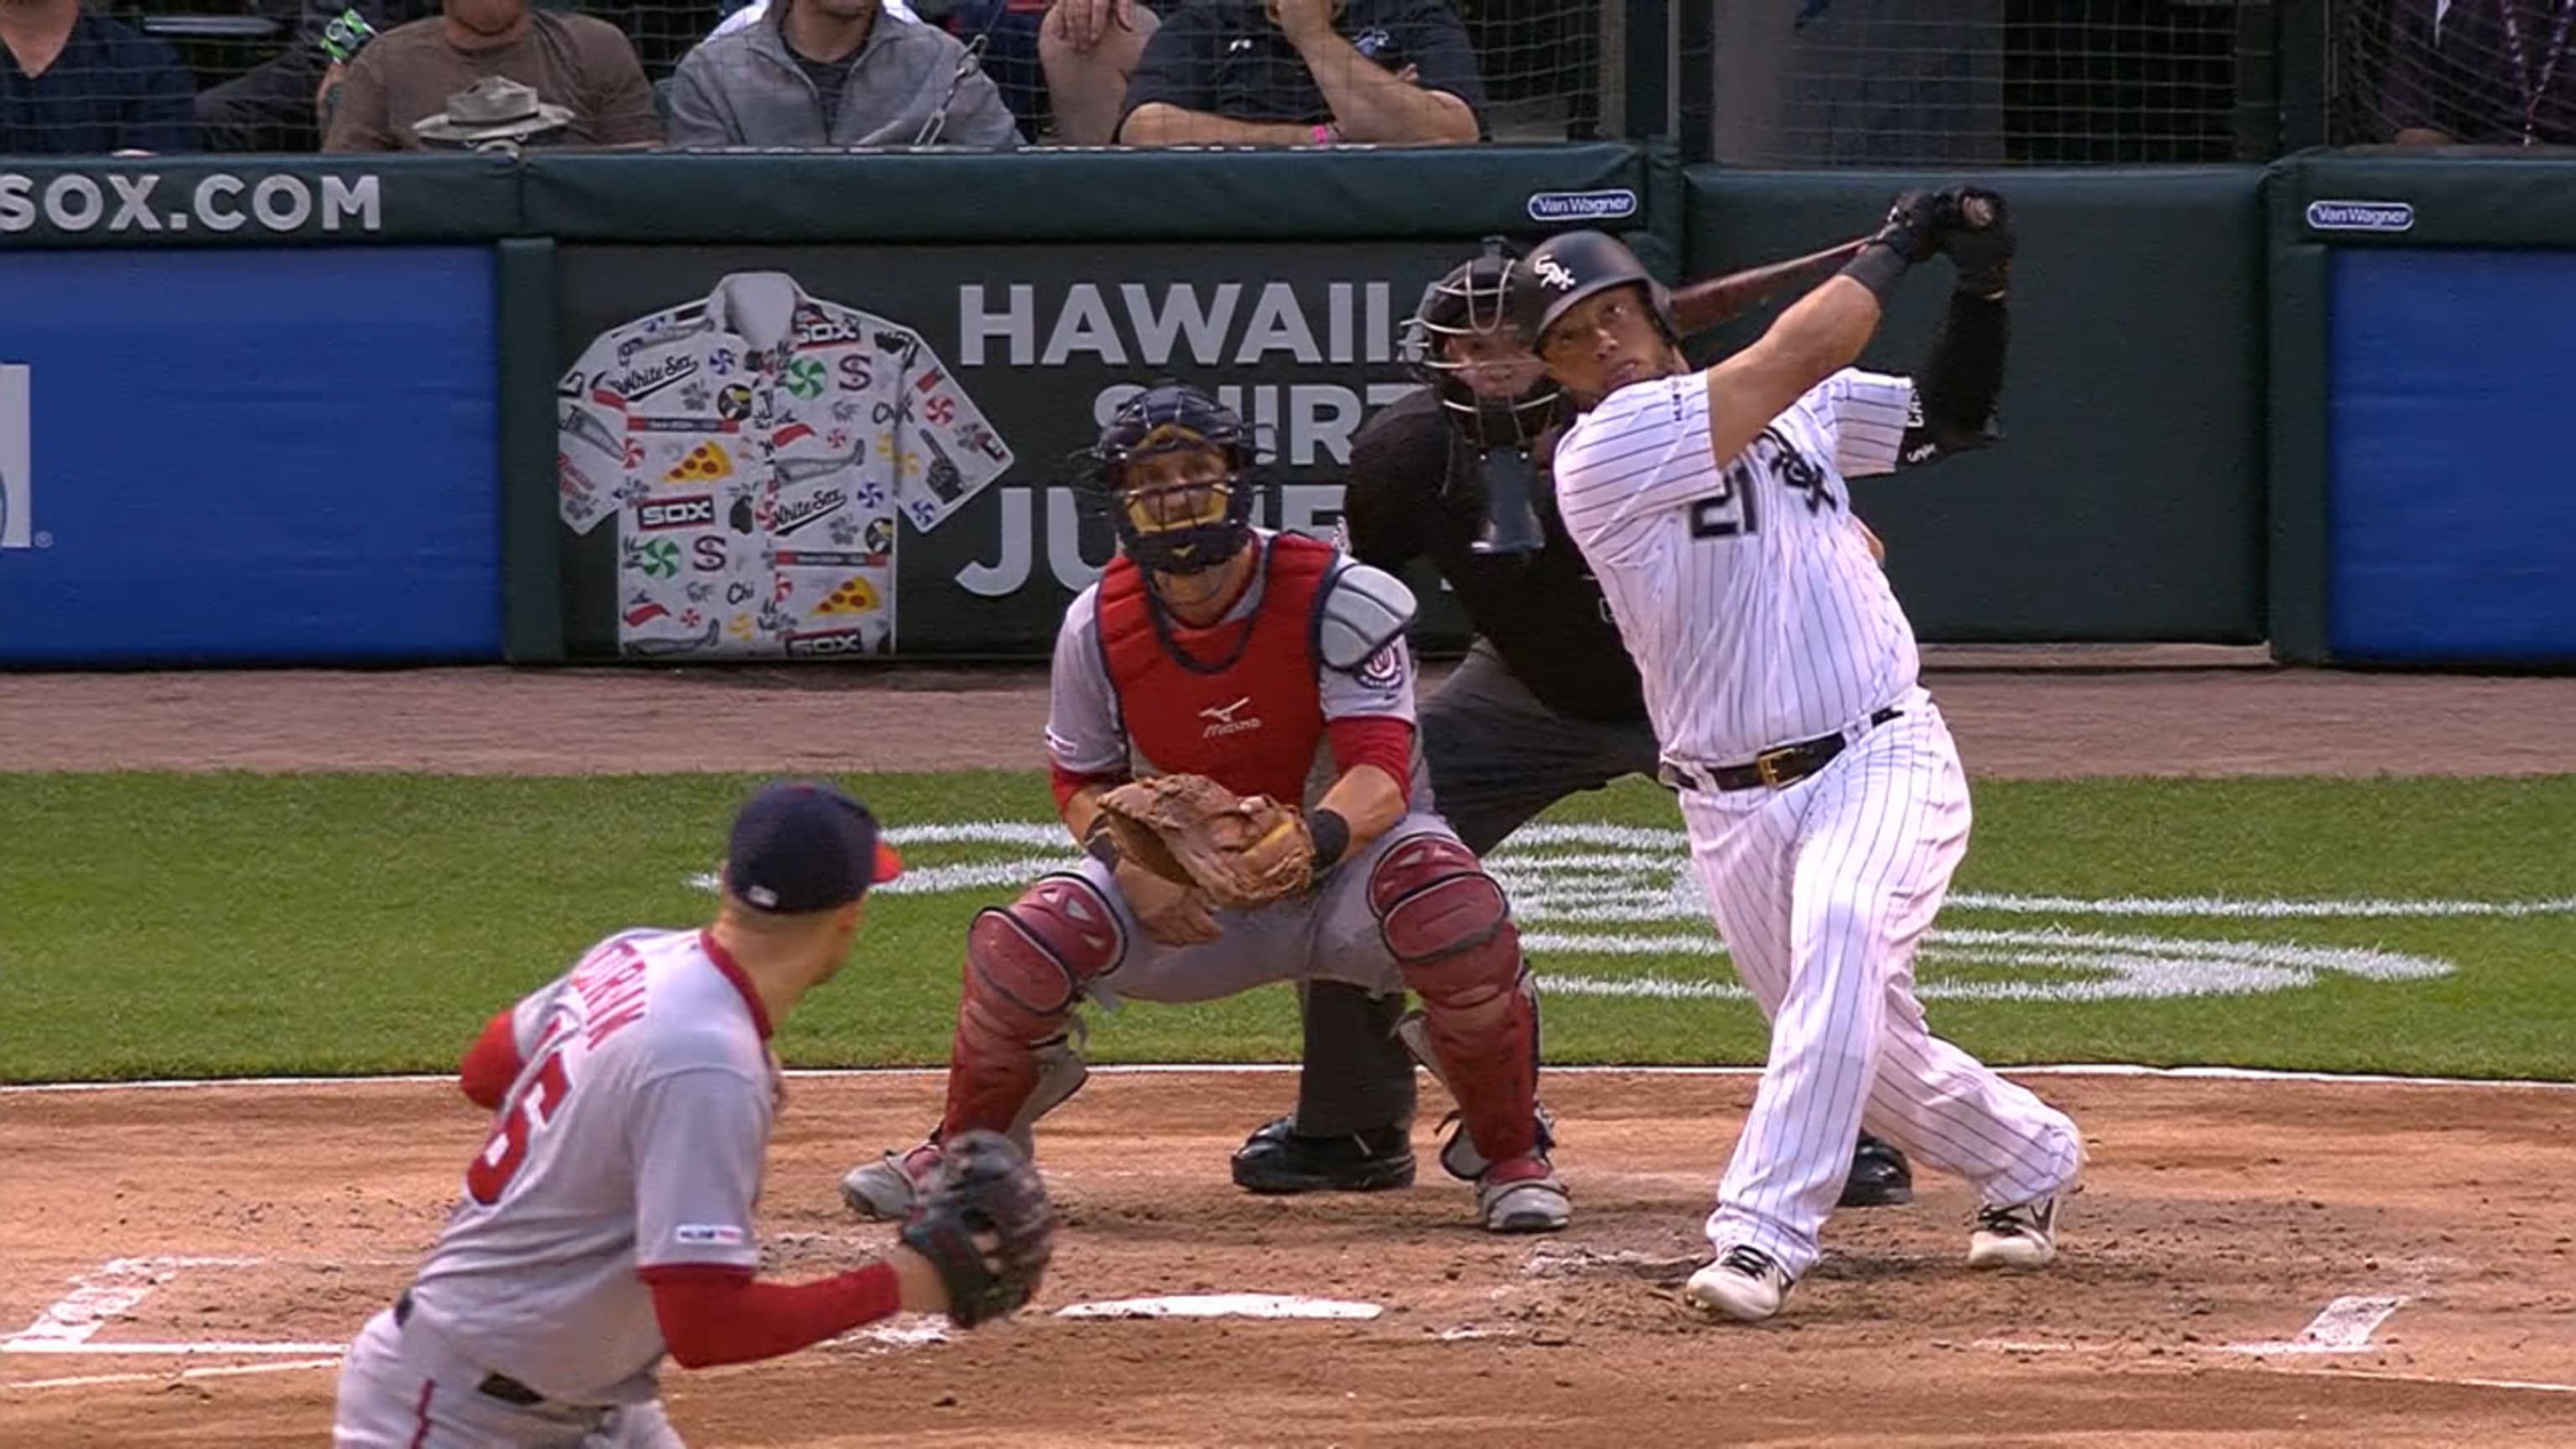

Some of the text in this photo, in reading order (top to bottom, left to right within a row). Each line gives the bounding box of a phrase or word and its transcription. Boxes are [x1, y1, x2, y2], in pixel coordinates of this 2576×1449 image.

[0, 173, 382, 231] SOX.COM
[1537, 195, 1631, 216] Van Wagner
[2317, 205, 2408, 227] Van Wagner
[641, 500, 712, 525] SOX
